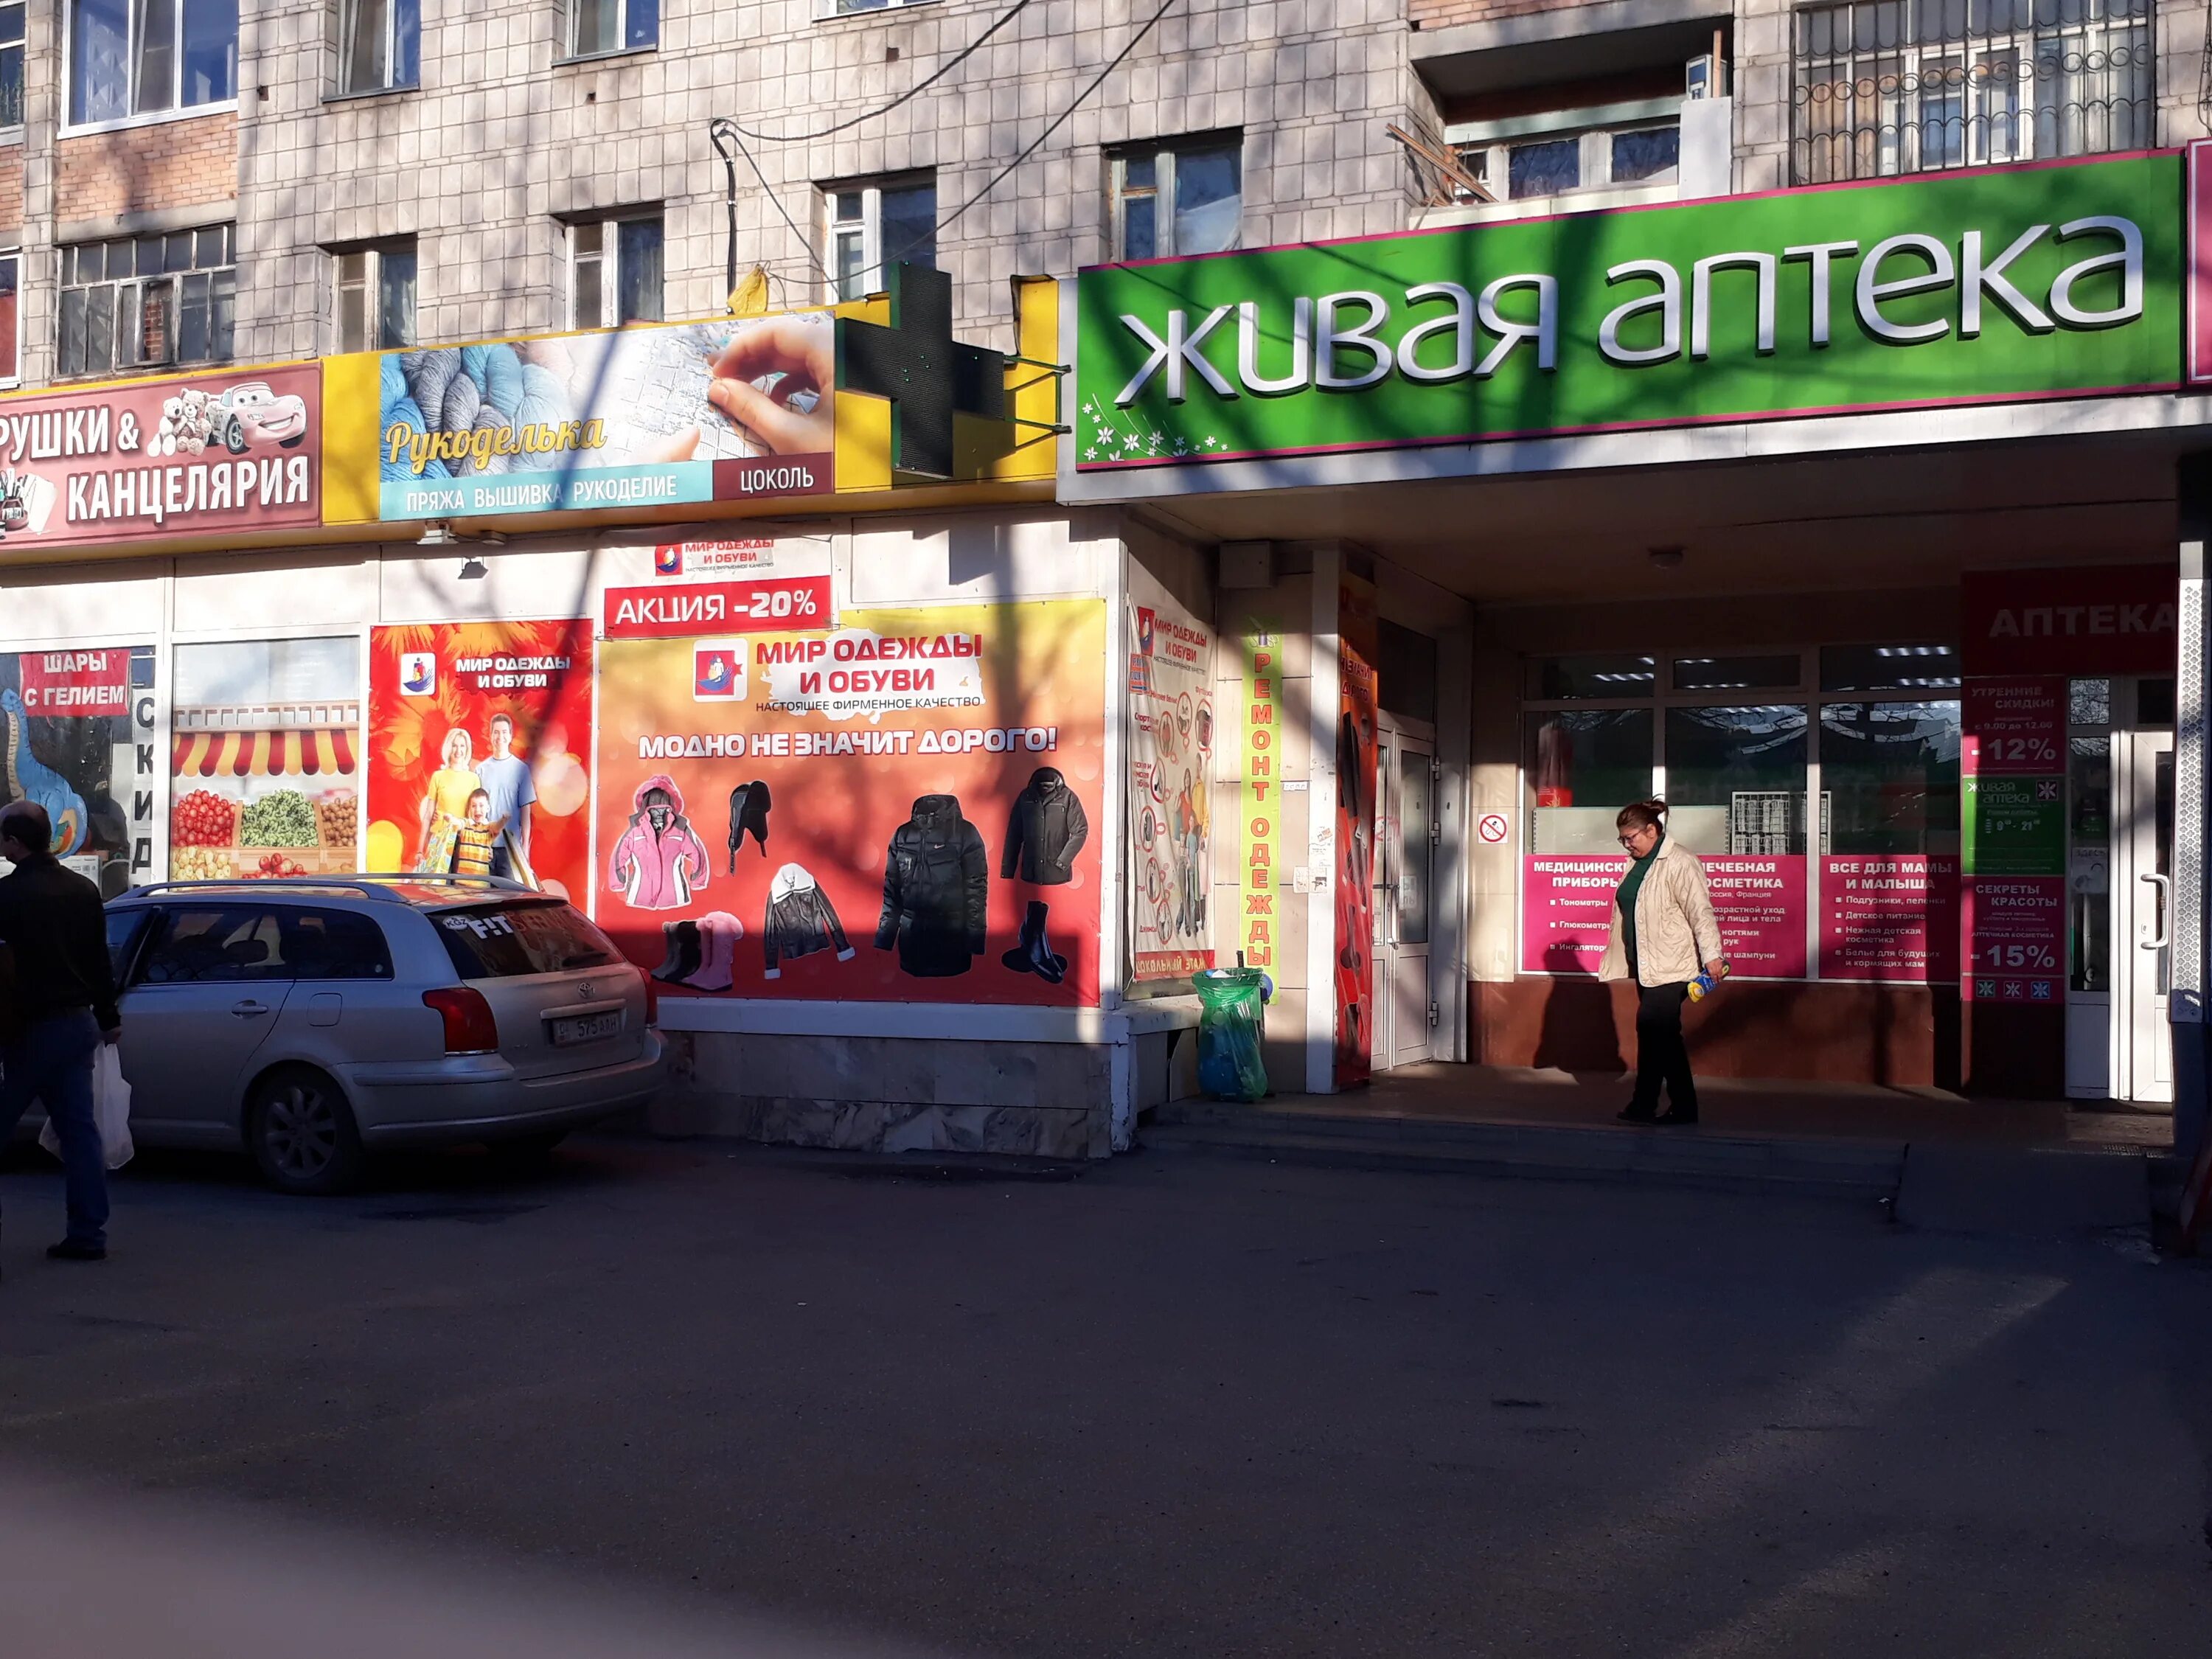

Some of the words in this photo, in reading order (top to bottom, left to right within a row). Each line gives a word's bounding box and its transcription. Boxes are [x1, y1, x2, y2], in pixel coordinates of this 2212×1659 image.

[1597, 215, 2144, 367] аптека
[119, 413, 139, 451] &
[386, 418, 607, 475] Рукоделька
[740, 467, 814, 494] ЦОКОЛЬ
[68, 456, 309, 524] КАНЦЕЛЯРИЯ
[407, 489, 465, 512] ПРЯЖА
[475, 483, 563, 508] ВЫШИВКА
[574, 475, 677, 502] РУКОДЕЛИЕ
[686, 543, 714, 552] МИР
[717, 540, 773, 550] ОДЕЖДЫ
[704, 555, 712, 564] И
[715, 552, 757, 563] ОБУВИ
[615, 594, 725, 625] АКЦИЯ
[734, 589, 816, 618] -20%
[1989, 602, 2176, 637] АПТЕКА
[1155, 619, 1172, 635] МИР
[1173, 625, 1206, 649] ОДЕЖДЫ
[757, 641, 826, 664] МИР
[834, 635, 981, 662] ОДЕЖДЫ
[1172, 644, 1197, 664] ОБУВИ
[44, 653, 107, 673] ШАРЫ
[456, 658, 493, 672] МИР
[495, 657, 570, 670] ОДЕЖДЫ
[479, 675, 490, 688] И
[493, 674, 546, 687] ОБУВИ
[801, 672, 821, 694] И
[829, 669, 934, 692] ОБУВИ
[25, 689, 37, 706] С
[44, 686, 125, 706] ГЕЛИЕМ
[757, 701, 829, 712] НАСТОЯЩЕЕ
[833, 699, 915, 709] ФИРМЕННОЕ
[916, 697, 980, 708] КАЧЕСТВО
[1994, 699, 2054, 709] СКИДКИ!
[1251, 653, 1273, 801] РЕМОНТ
[639, 734, 745, 759] МОДНО
[751, 733, 789, 757] НЕ
[794, 731, 914, 756] ЗНАЧИТ
[918, 727, 1057, 754] ДОРОГО!
[132, 697, 155, 888] СКИД
[1983, 793, 2029, 803] аптека
[1534, 862, 1626, 874] МЕДИЦИНСК
[1829, 863, 1860, 873] ВСЕ
[1864, 862, 1896, 874] ДЛЯ
[1902, 862, 1952, 873] МАМЫ
[1706, 877, 1784, 888] ОСМЕТИКА
[1846, 879, 1857, 889] И
[1861, 879, 1935, 889] МАЛЫША
[1976, 884, 2040, 894] СЕКРЕТЫ
[1247, 817, 1273, 967] ОДЕЖДЫ
[1736, 890, 1771, 899] Франция
[1559, 898, 1608, 908] Тонометры
[1992, 897, 2057, 907] КРАСОТЫ
[1713, 905, 1761, 914] озрастной
[1763, 907, 1786, 915] уход
[1846, 911, 1883, 920] Детское
[1727, 915, 1750, 923] лица
[1559, 945, 1607, 953] Ингалятор
[1723, 938, 1739, 946] рук
[1733, 952, 1775, 960] шампуни
